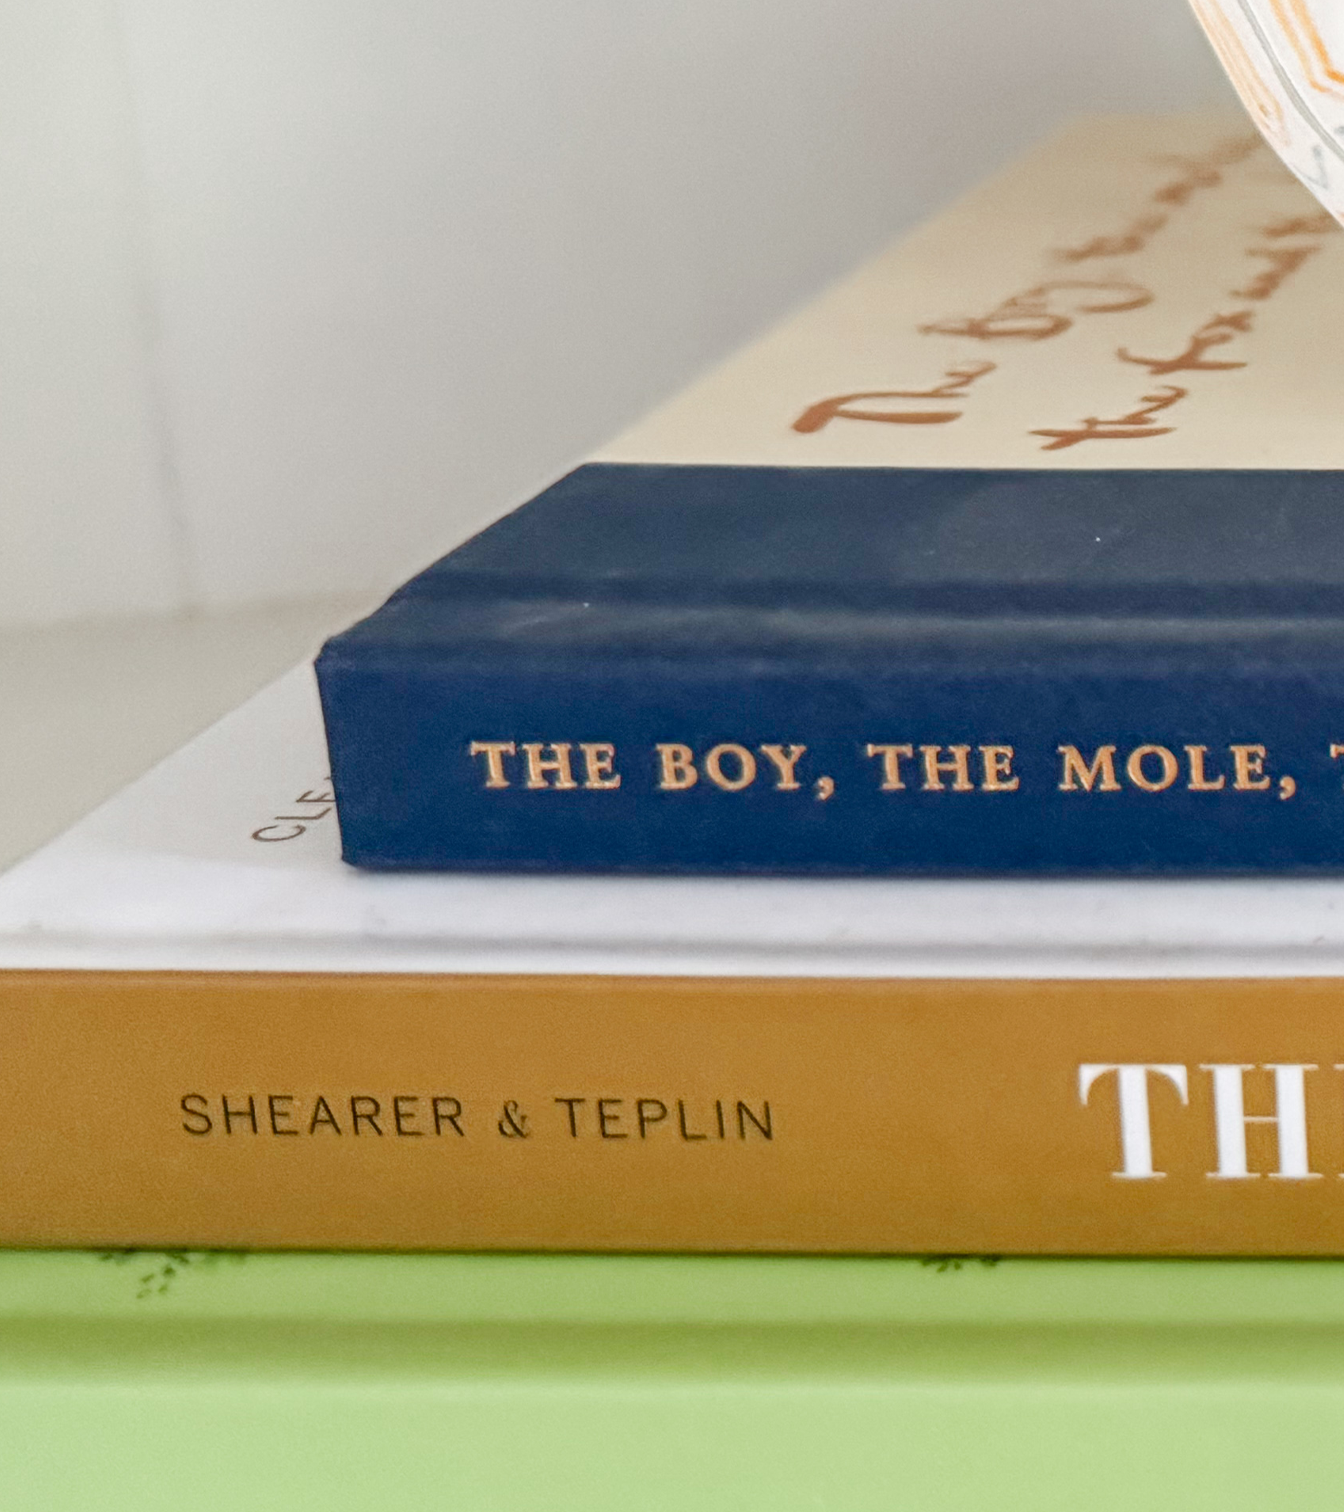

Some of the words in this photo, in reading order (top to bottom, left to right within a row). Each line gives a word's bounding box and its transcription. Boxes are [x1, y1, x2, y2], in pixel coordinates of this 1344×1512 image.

[792, 359, 998, 434] The
[1028, 387, 1188, 450] the
[471, 742, 622, 791] THE
[657, 744, 835, 801] BOY,
[867, 744, 1021, 793] THE
[1059, 745, 1297, 801] MOLE,
[252, 776, 337, 842] CLE
[181, 1094, 466, 1138] SHEARER
[498, 1101, 530, 1140] &
[555, 1098, 774, 1143] TEPLIN
